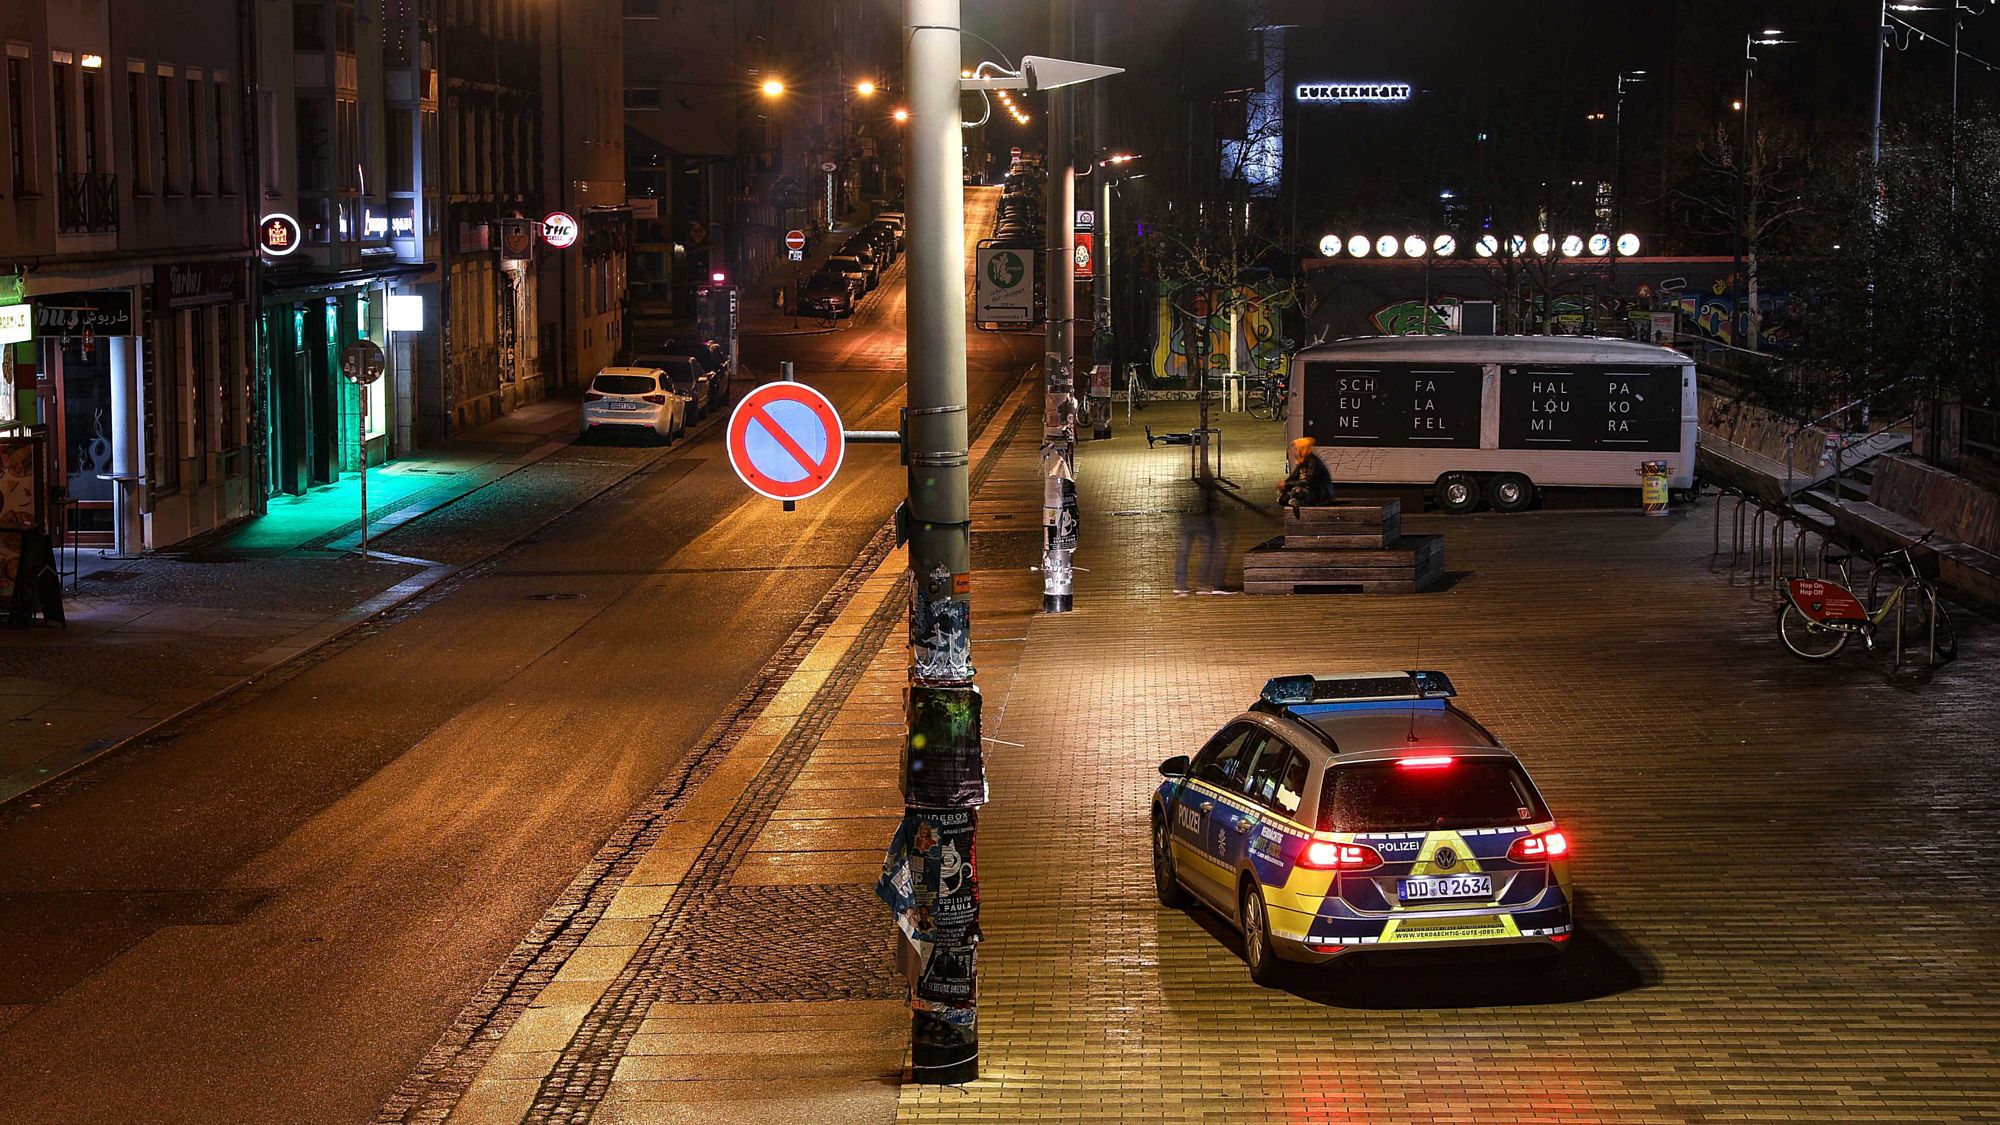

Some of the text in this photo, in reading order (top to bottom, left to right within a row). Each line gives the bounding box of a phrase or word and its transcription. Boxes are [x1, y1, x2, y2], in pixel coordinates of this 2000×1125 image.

[1340, 379, 1374, 391] SCH
[1415, 380, 1435, 391] FA
[1532, 382, 1567, 394] HAL
[1609, 383, 1630, 394] PA
[1340, 398, 1361, 409] EU
[1414, 399, 1435, 411] LA
[1608, 402, 1630, 413] KO
[1339, 416, 1360, 428] NE
[1414, 418, 1446, 429] FEL
[1531, 419, 1552, 431] MI
[1608, 420, 1629, 431] RA
[1179, 803, 1200, 834] POLIZEI
[1378, 842, 1420, 852] POLIZEI
[1407, 878, 1490, 897] DD Q 2634
